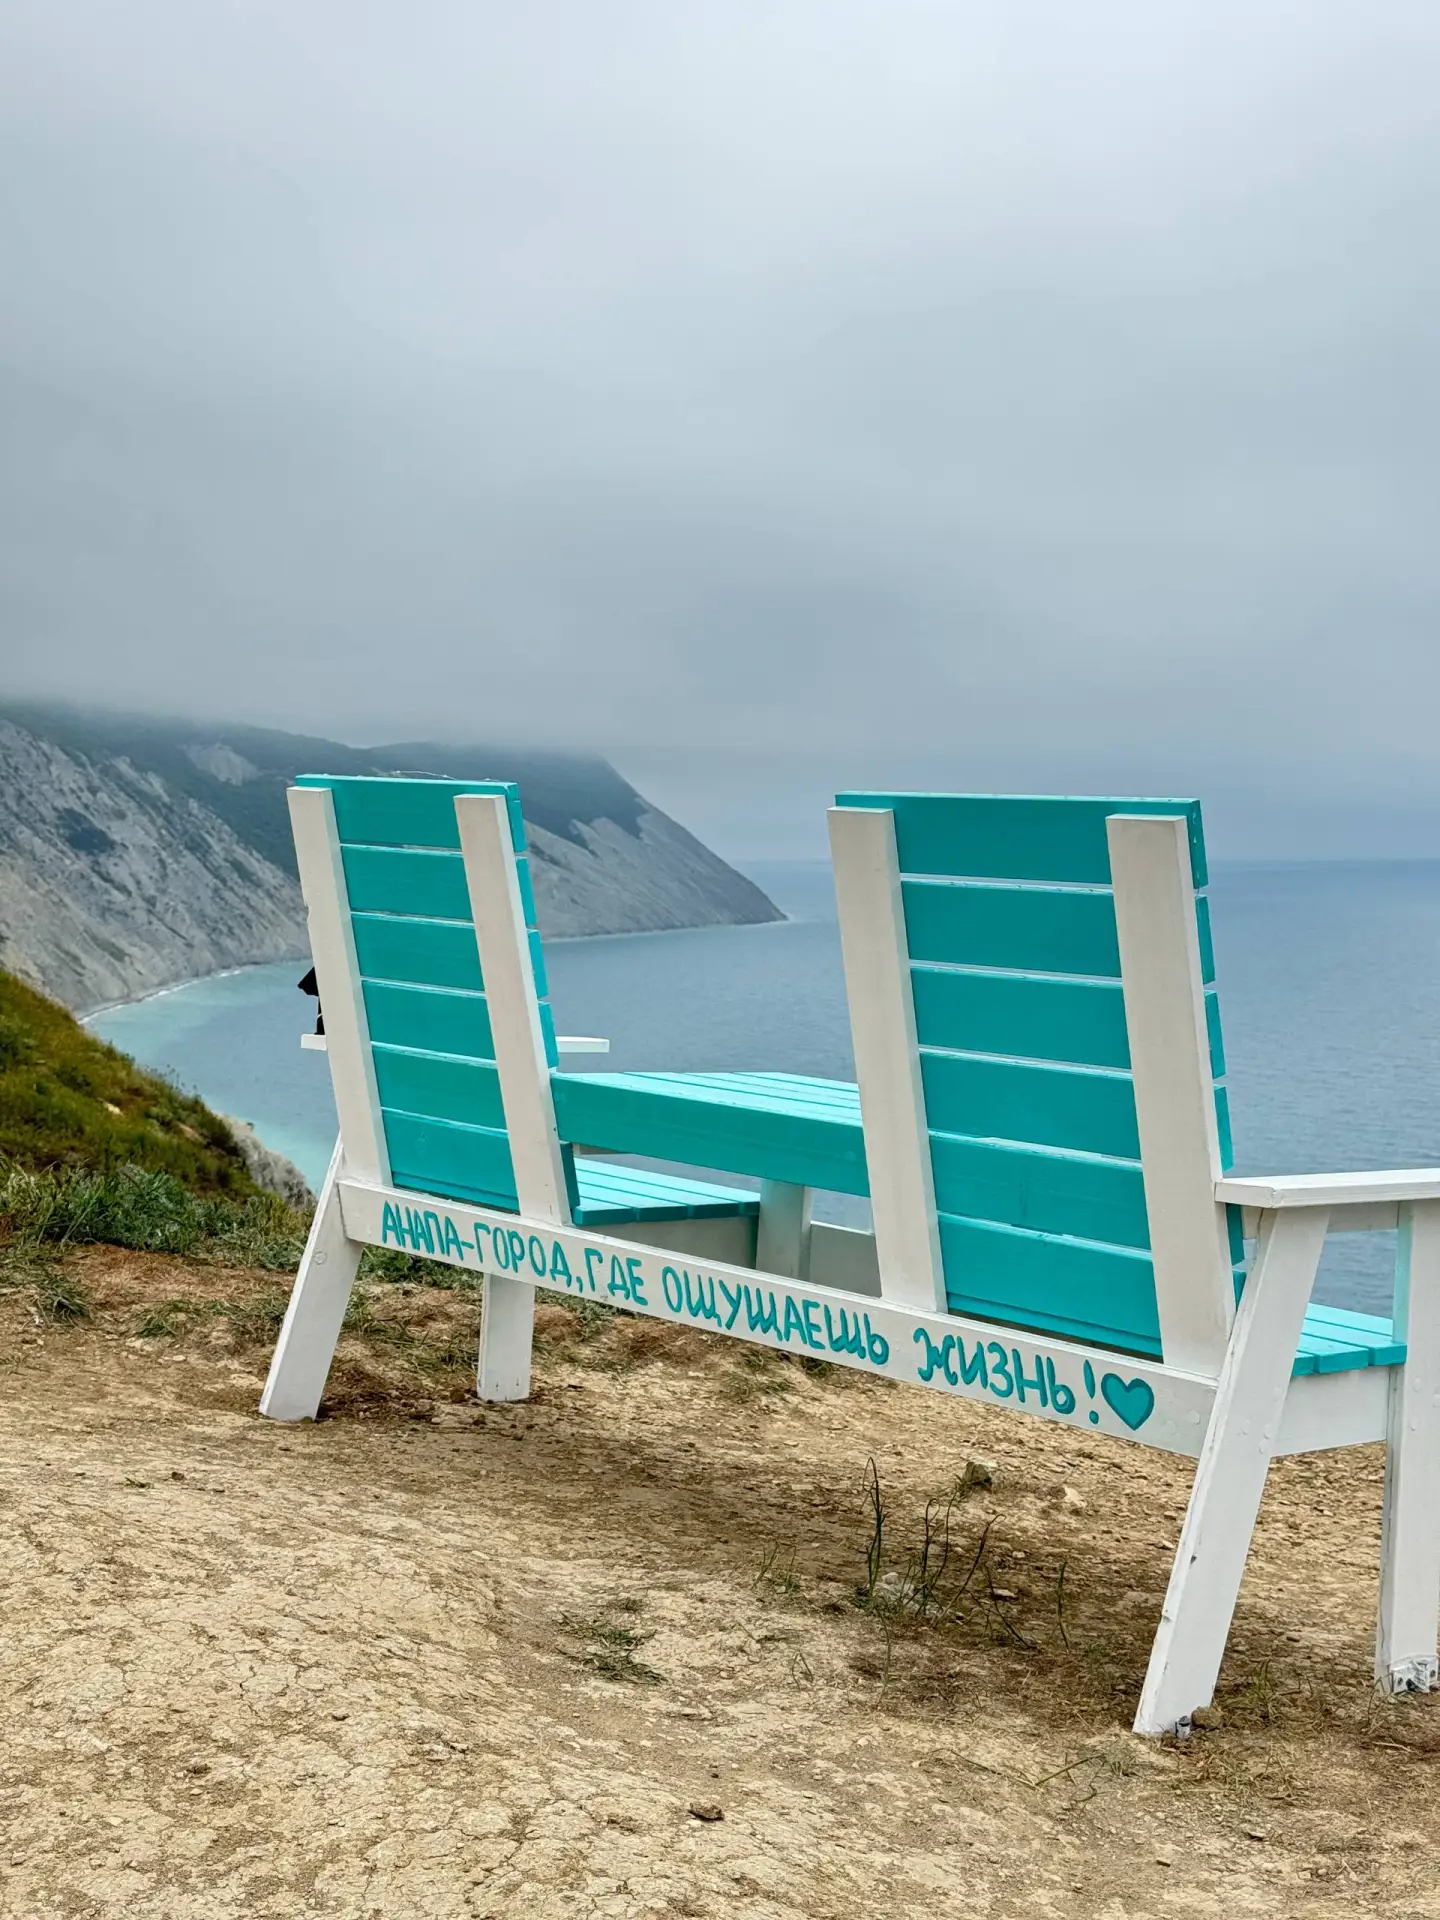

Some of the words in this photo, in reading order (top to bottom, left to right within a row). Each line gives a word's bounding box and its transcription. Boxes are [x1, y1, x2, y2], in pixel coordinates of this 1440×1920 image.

[583, 1247, 649, 1307] ГДЕ
[661, 1265, 890, 1366] ОЩУЩАЕШЬ
[912, 1327, 1100, 1425] ЖИЗНЬ!
